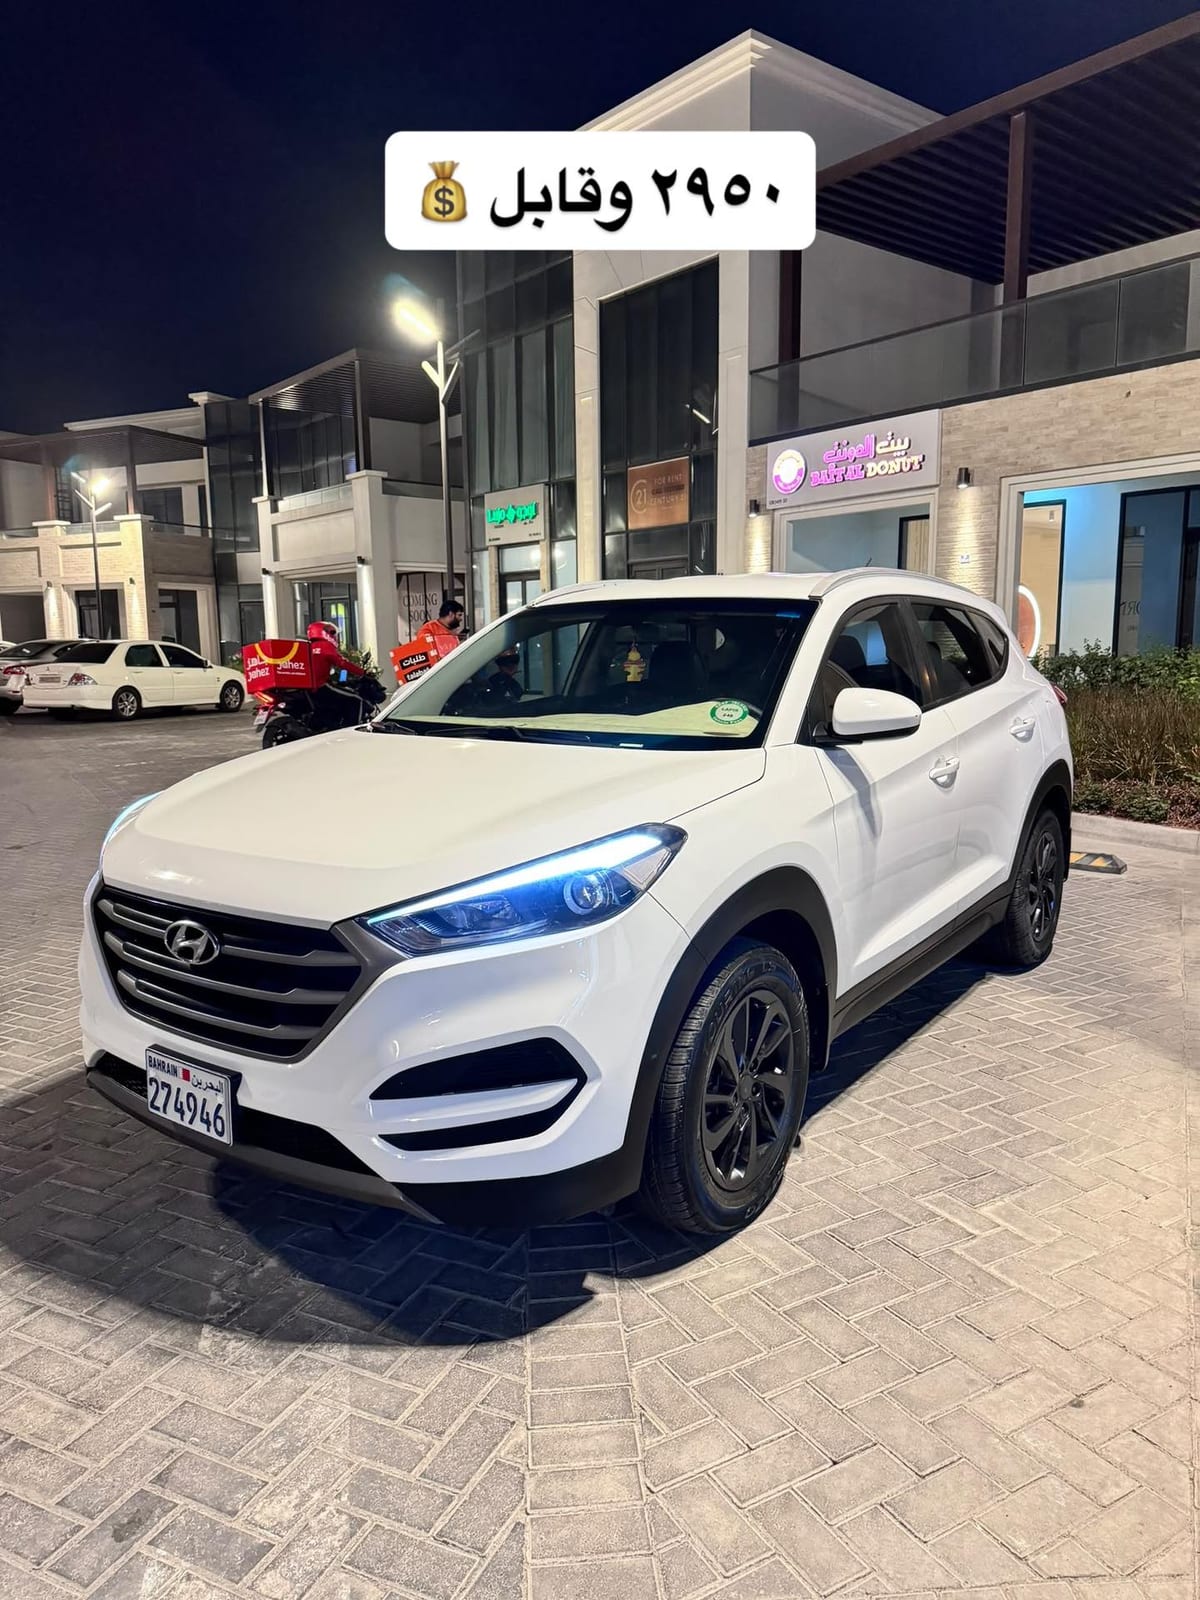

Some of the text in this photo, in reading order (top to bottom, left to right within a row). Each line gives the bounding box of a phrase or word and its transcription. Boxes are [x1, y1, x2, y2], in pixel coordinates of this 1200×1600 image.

[876, 431, 911, 457] بيت
[810, 454, 925, 487] BAIT AL DONUT
[403, 593, 438, 607] COMING
[411, 609, 431, 621] SOON
[402, 654, 426, 667] طلبات
[148, 1056, 224, 1096] BAHRAIN البحرين
[149, 1077, 225, 1138] 274946
